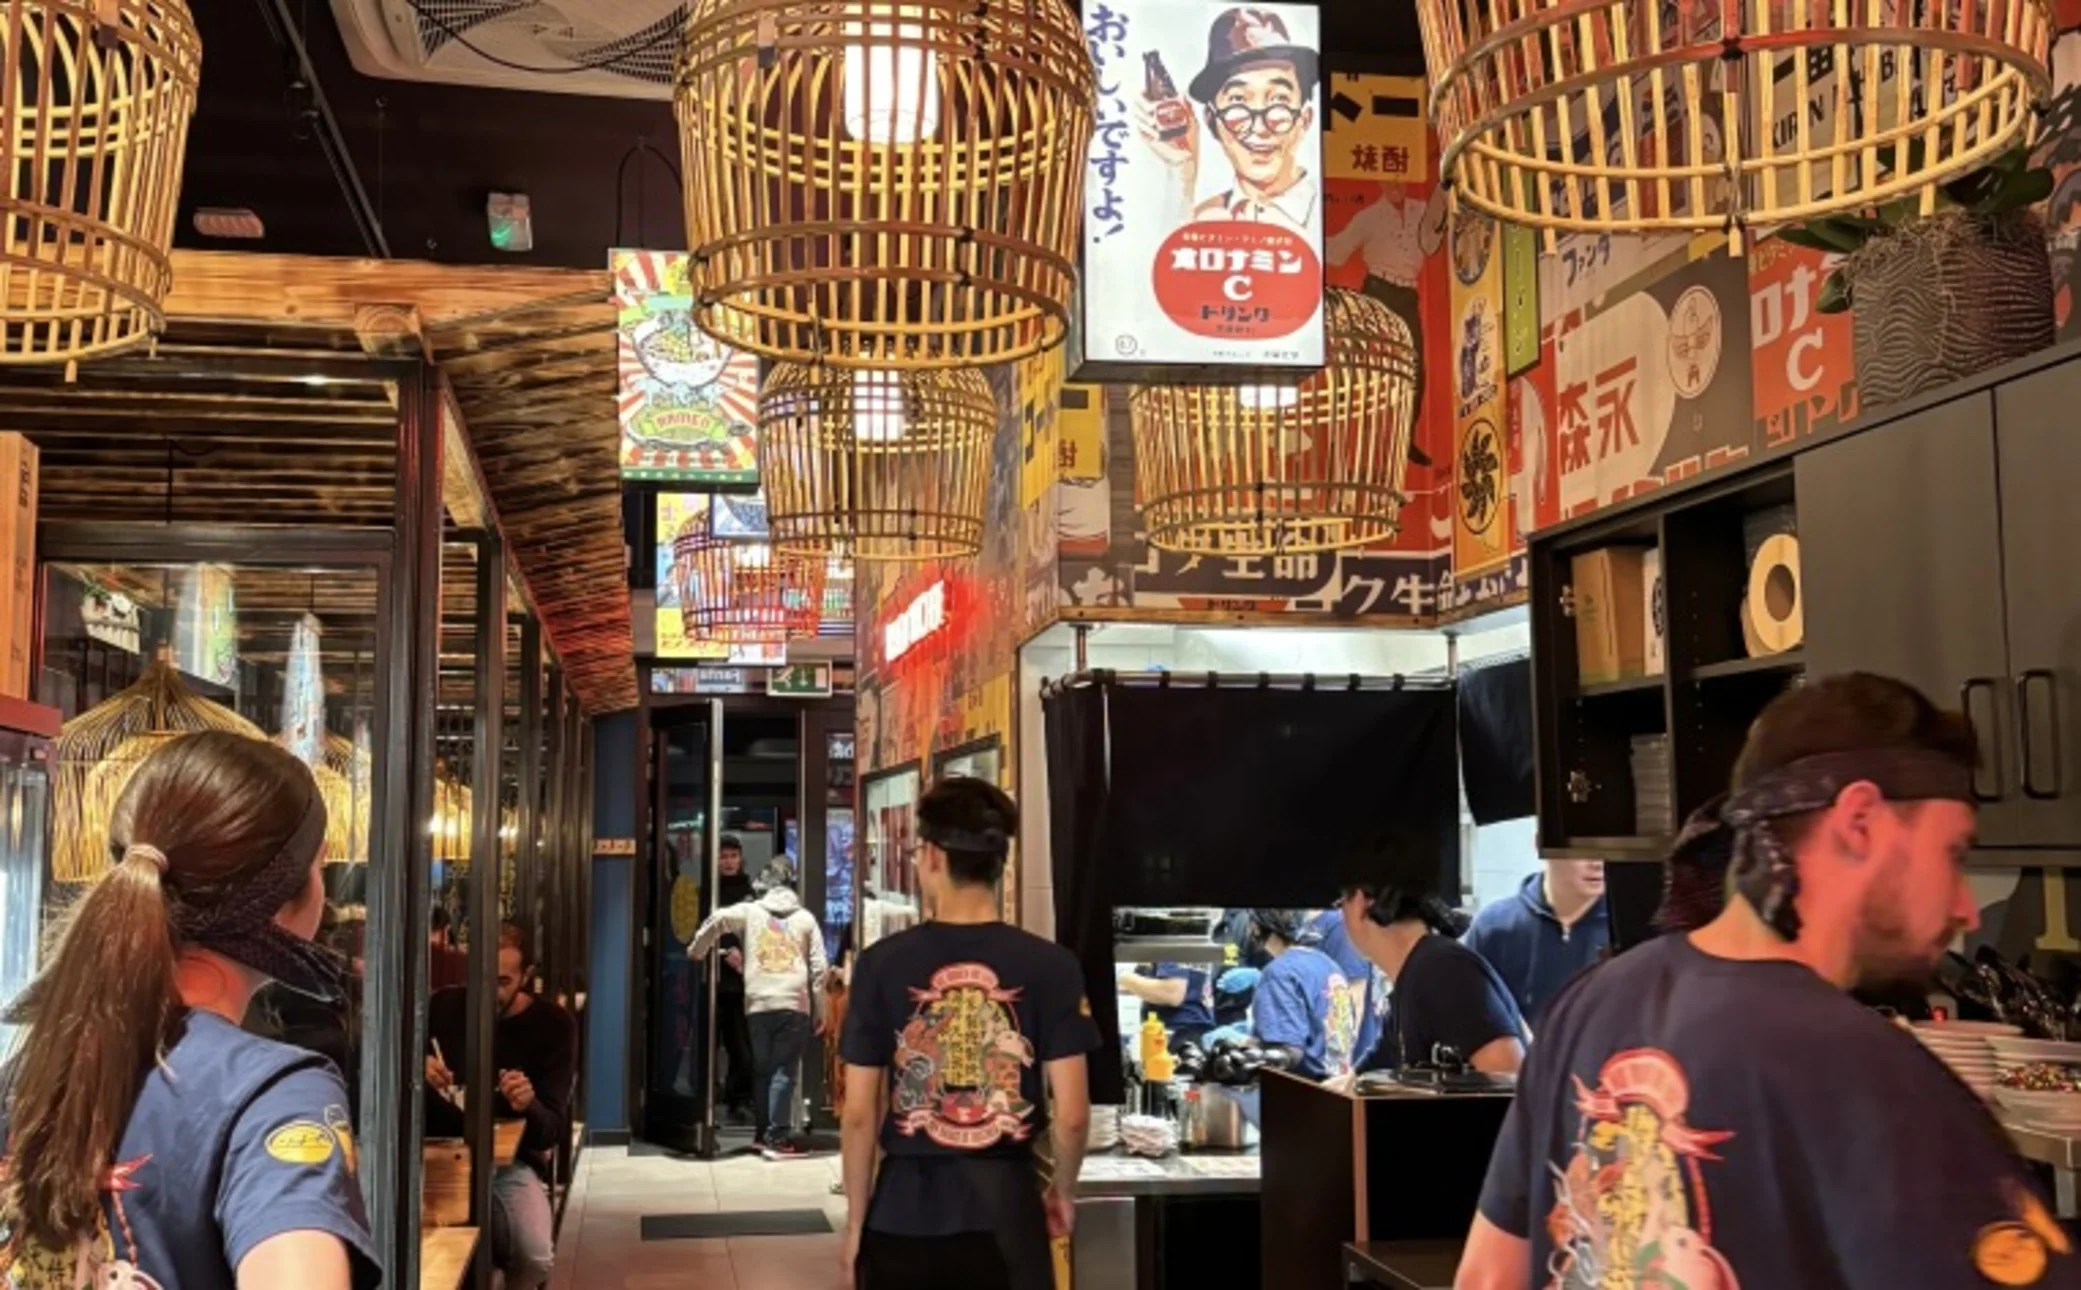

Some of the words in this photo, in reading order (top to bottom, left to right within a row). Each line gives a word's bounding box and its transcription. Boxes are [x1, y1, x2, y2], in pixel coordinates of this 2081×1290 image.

[1351, 144, 1410, 174] 焼酎
[1171, 246, 1303, 275] オロナミン
[1222, 274, 1254, 302] C
[1786, 327, 1825, 392] C
[1559, 354, 1641, 477] 森永
